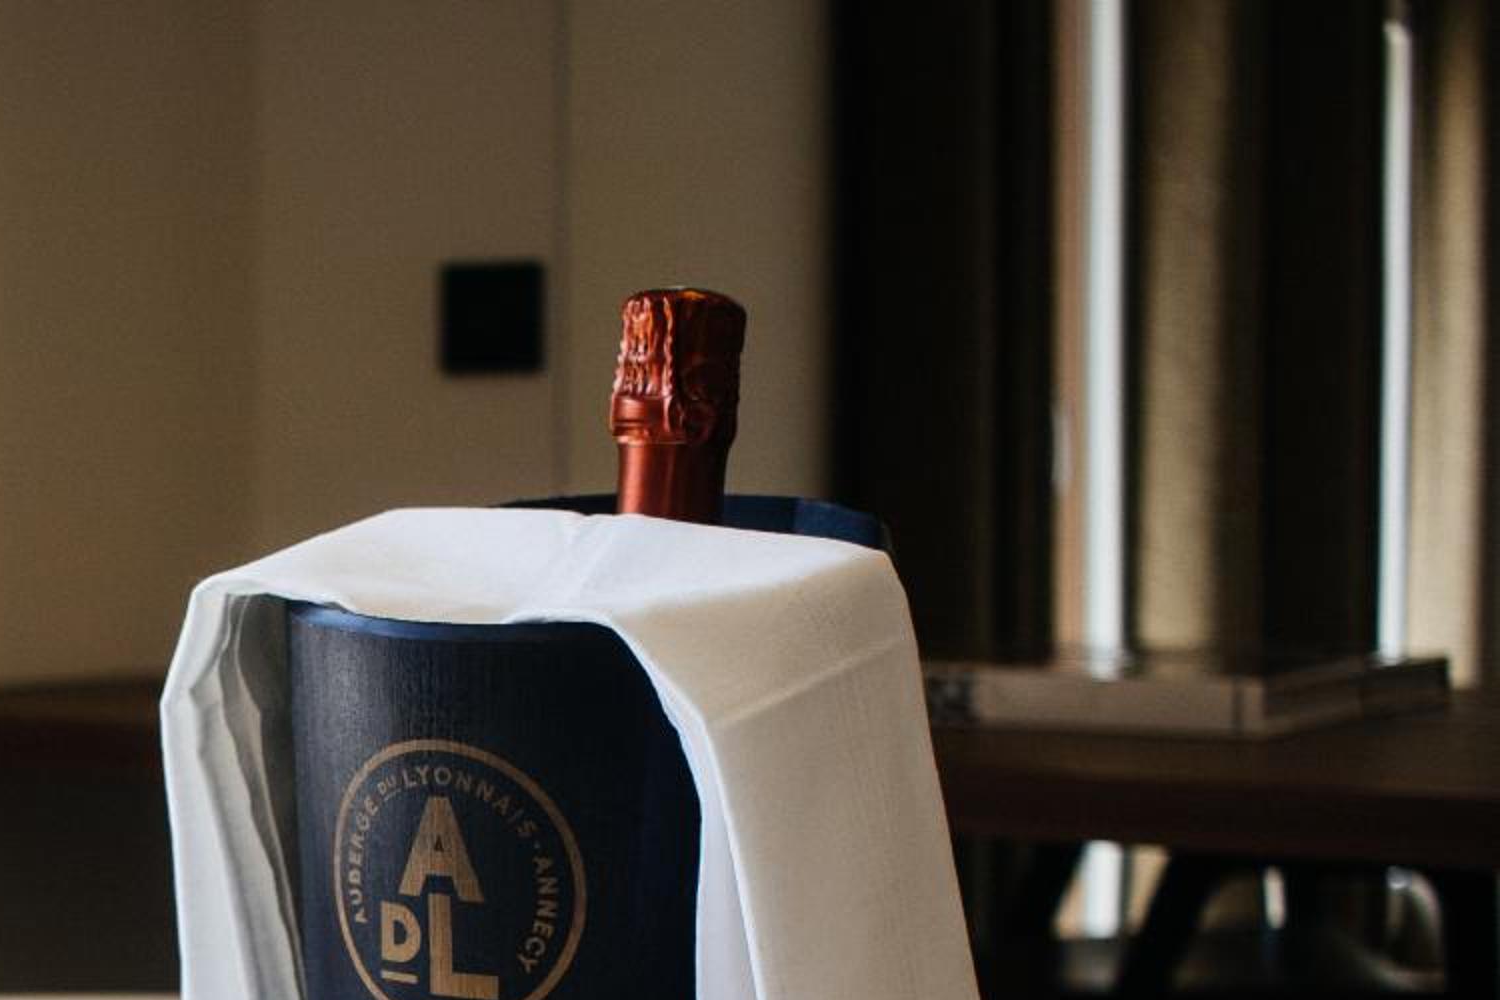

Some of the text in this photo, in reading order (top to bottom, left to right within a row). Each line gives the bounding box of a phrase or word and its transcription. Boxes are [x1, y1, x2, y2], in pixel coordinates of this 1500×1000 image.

[349, 765, 559, 974] AUBERGE DU LYONNAIS ANNECY
